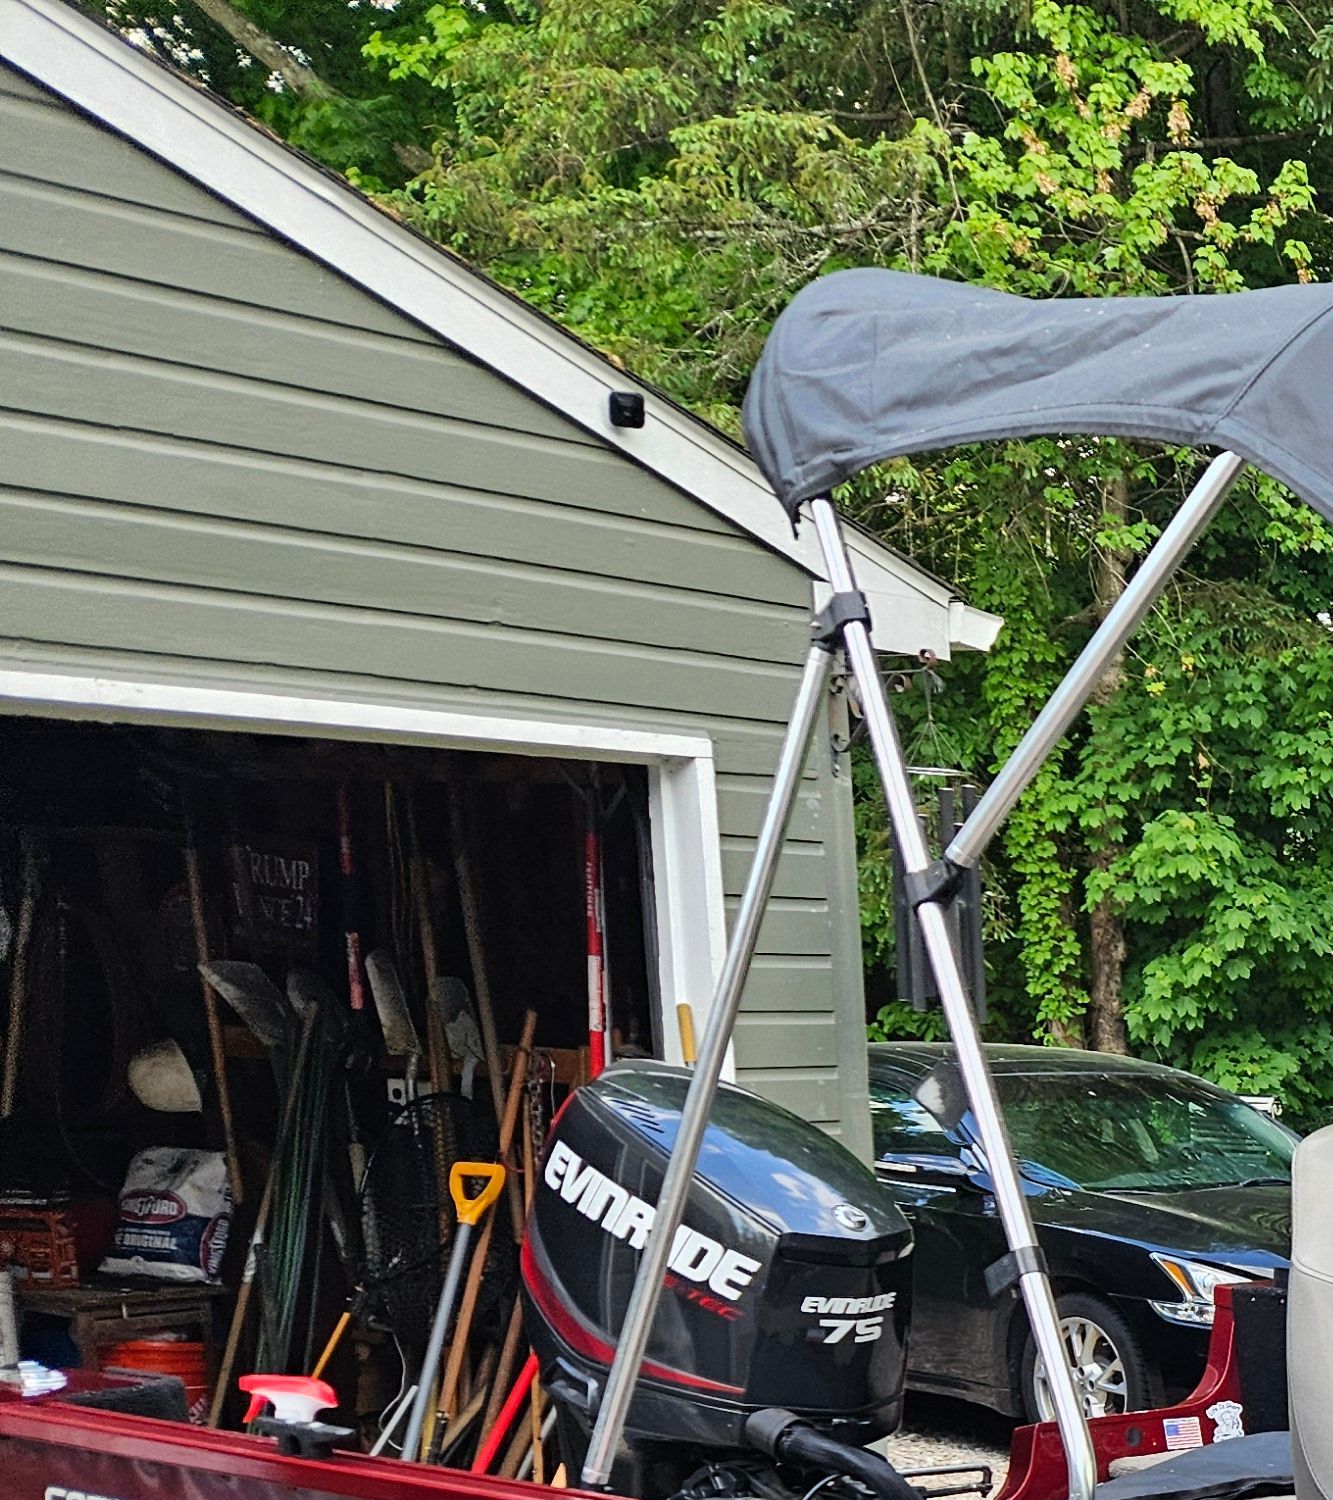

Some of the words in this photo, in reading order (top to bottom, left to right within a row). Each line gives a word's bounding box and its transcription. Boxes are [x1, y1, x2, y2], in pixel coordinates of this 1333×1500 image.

[544, 1140, 763, 1301] EVINRDE
[801, 1292, 897, 1315] EVINRUDE
[820, 1316, 884, 1344] 75
